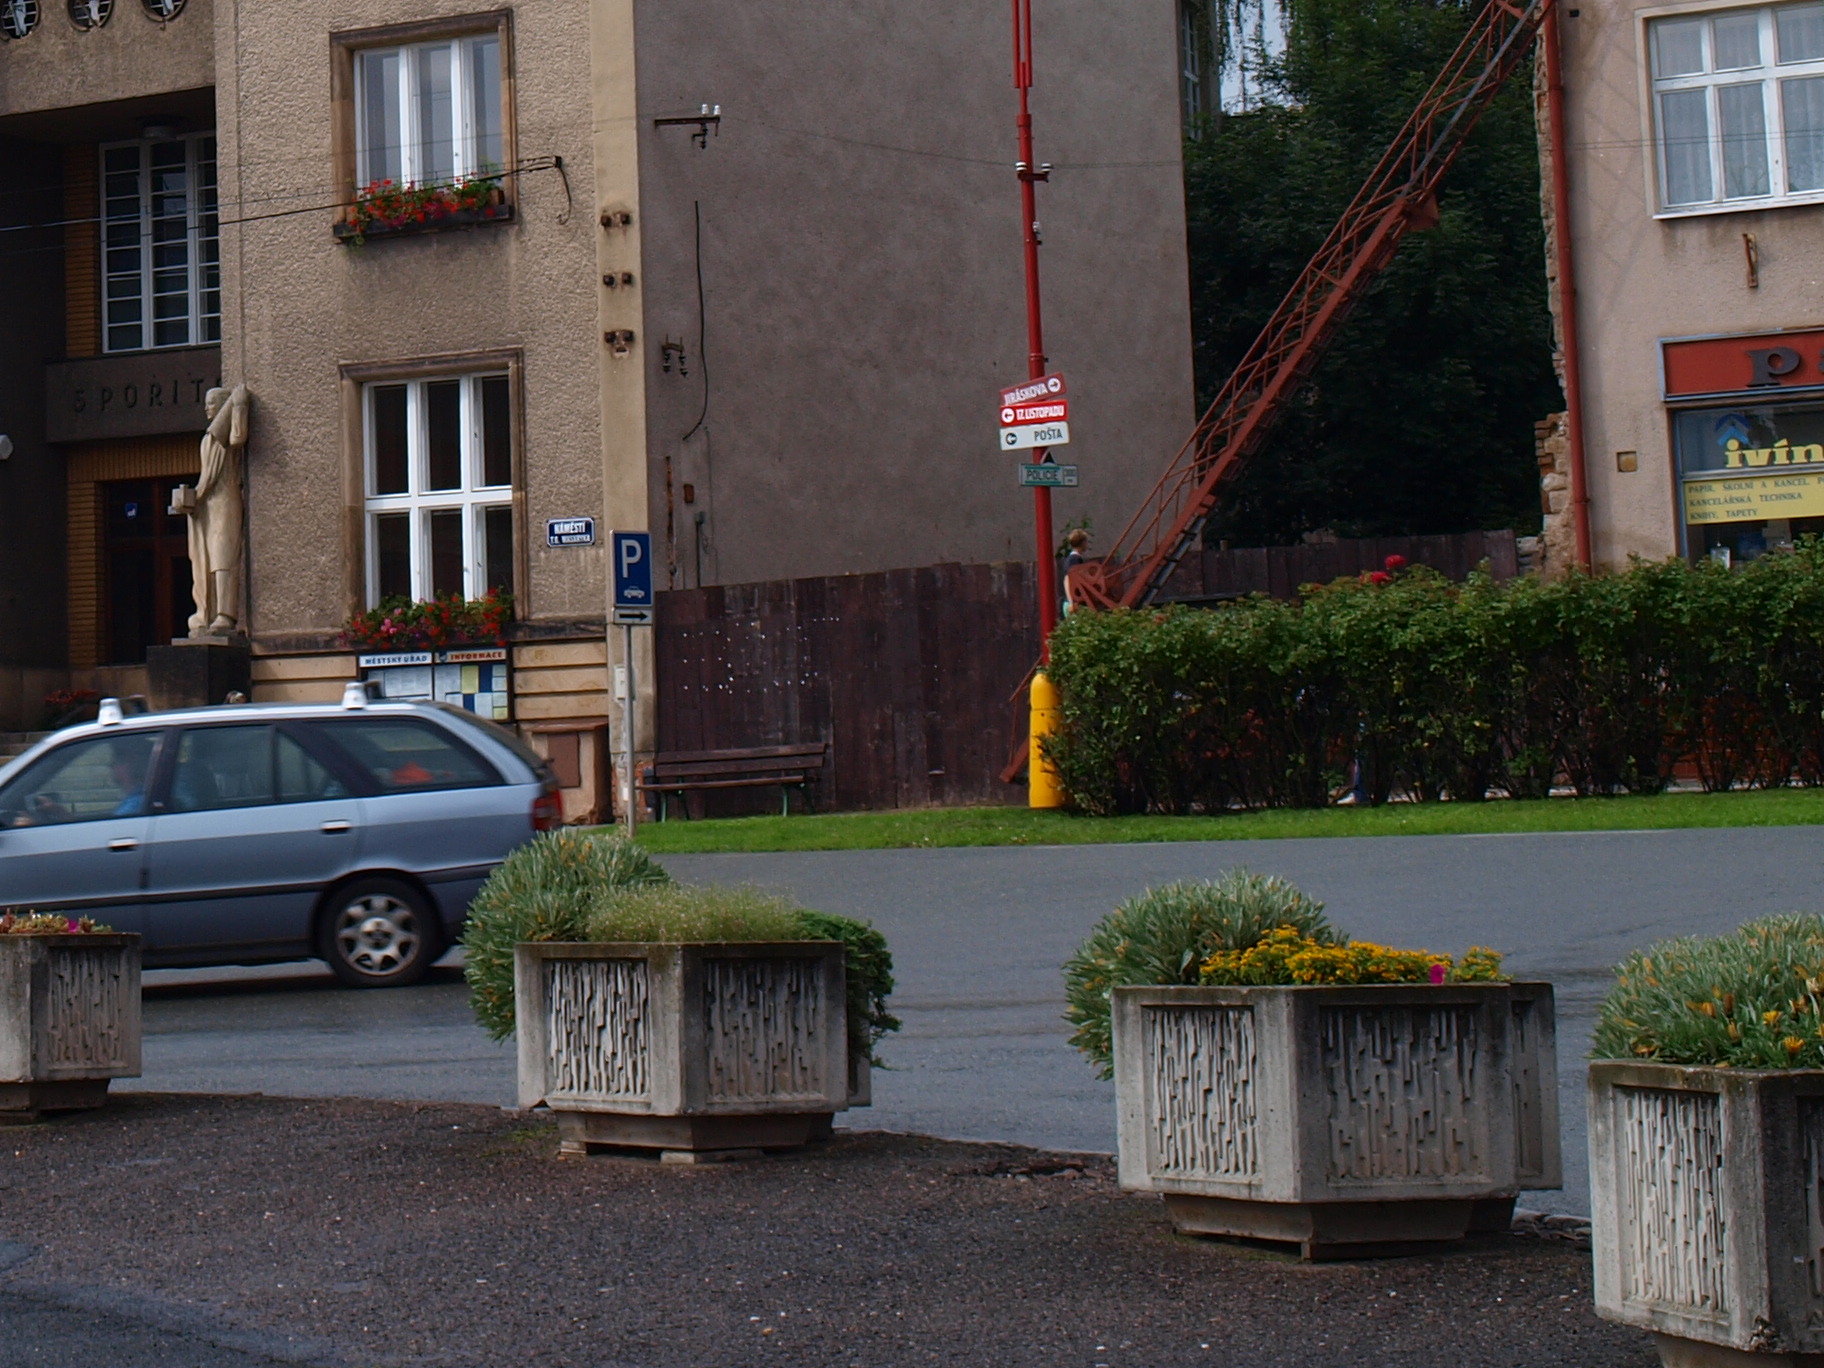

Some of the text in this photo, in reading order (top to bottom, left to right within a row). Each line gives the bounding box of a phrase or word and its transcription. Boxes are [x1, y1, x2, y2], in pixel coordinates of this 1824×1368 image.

[1025, 405, 1065, 420] LISTOPADU
[1034, 427, 1063, 441] POŠTA
[1026, 469, 1058, 481] POLICIE
[1760, 493, 1803, 502] TECHNIKA
[1726, 508, 1758, 518] TAPETY
[621, 539, 642, 578] P
[450, 651, 503, 661] INFORMACE
